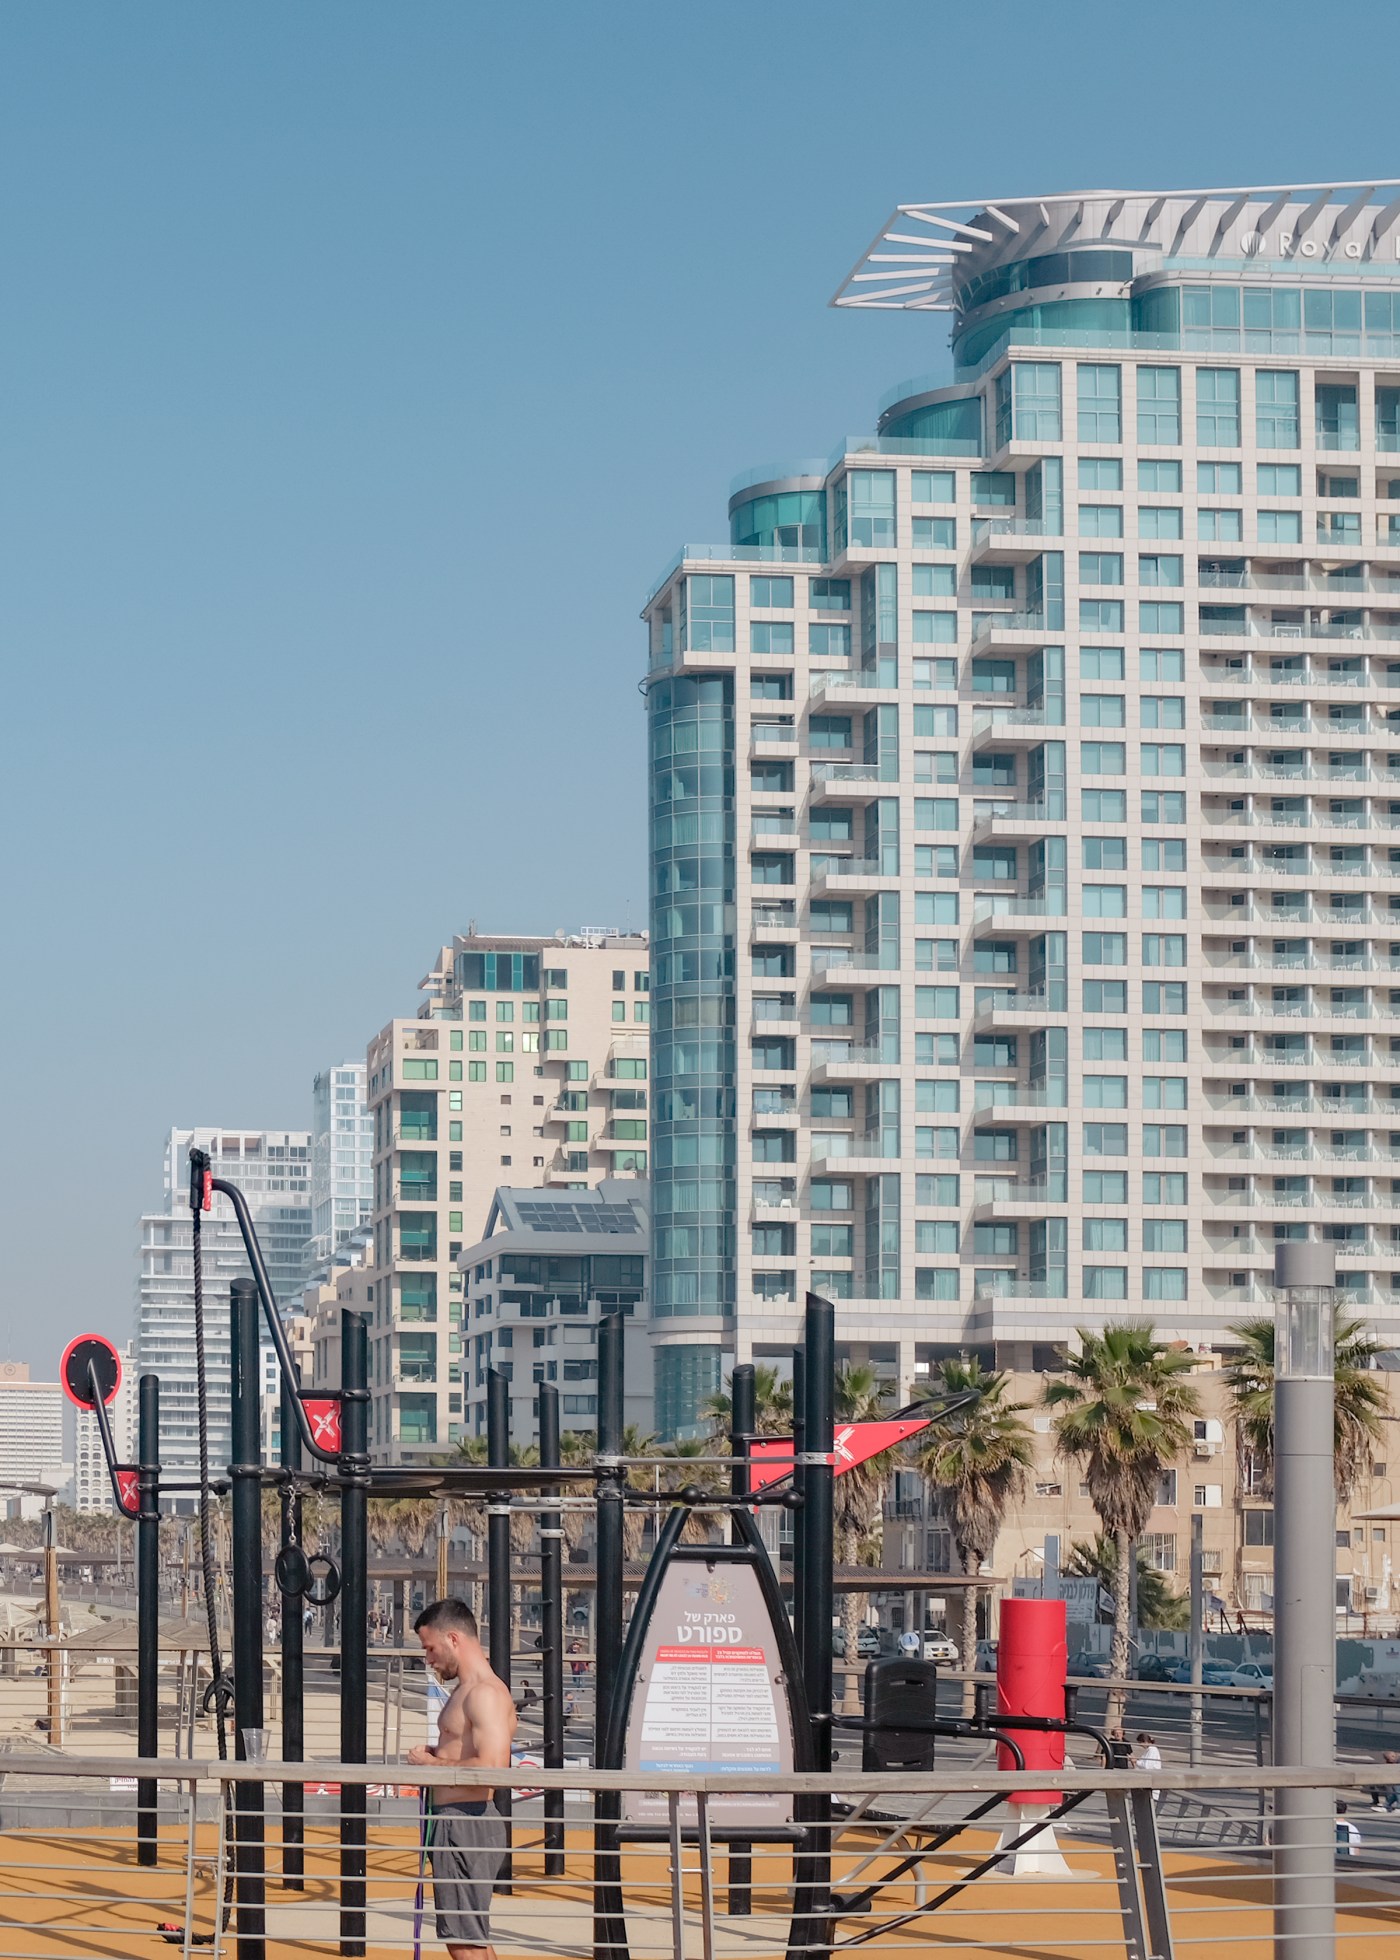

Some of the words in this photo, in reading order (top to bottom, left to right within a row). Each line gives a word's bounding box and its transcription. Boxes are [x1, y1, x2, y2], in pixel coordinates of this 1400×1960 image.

[1278, 231, 1375, 263] Royal
[684, 1611, 701, 1623] של
[704, 1613, 736, 1624] פארק
[676, 1625, 743, 1644] ספורט
